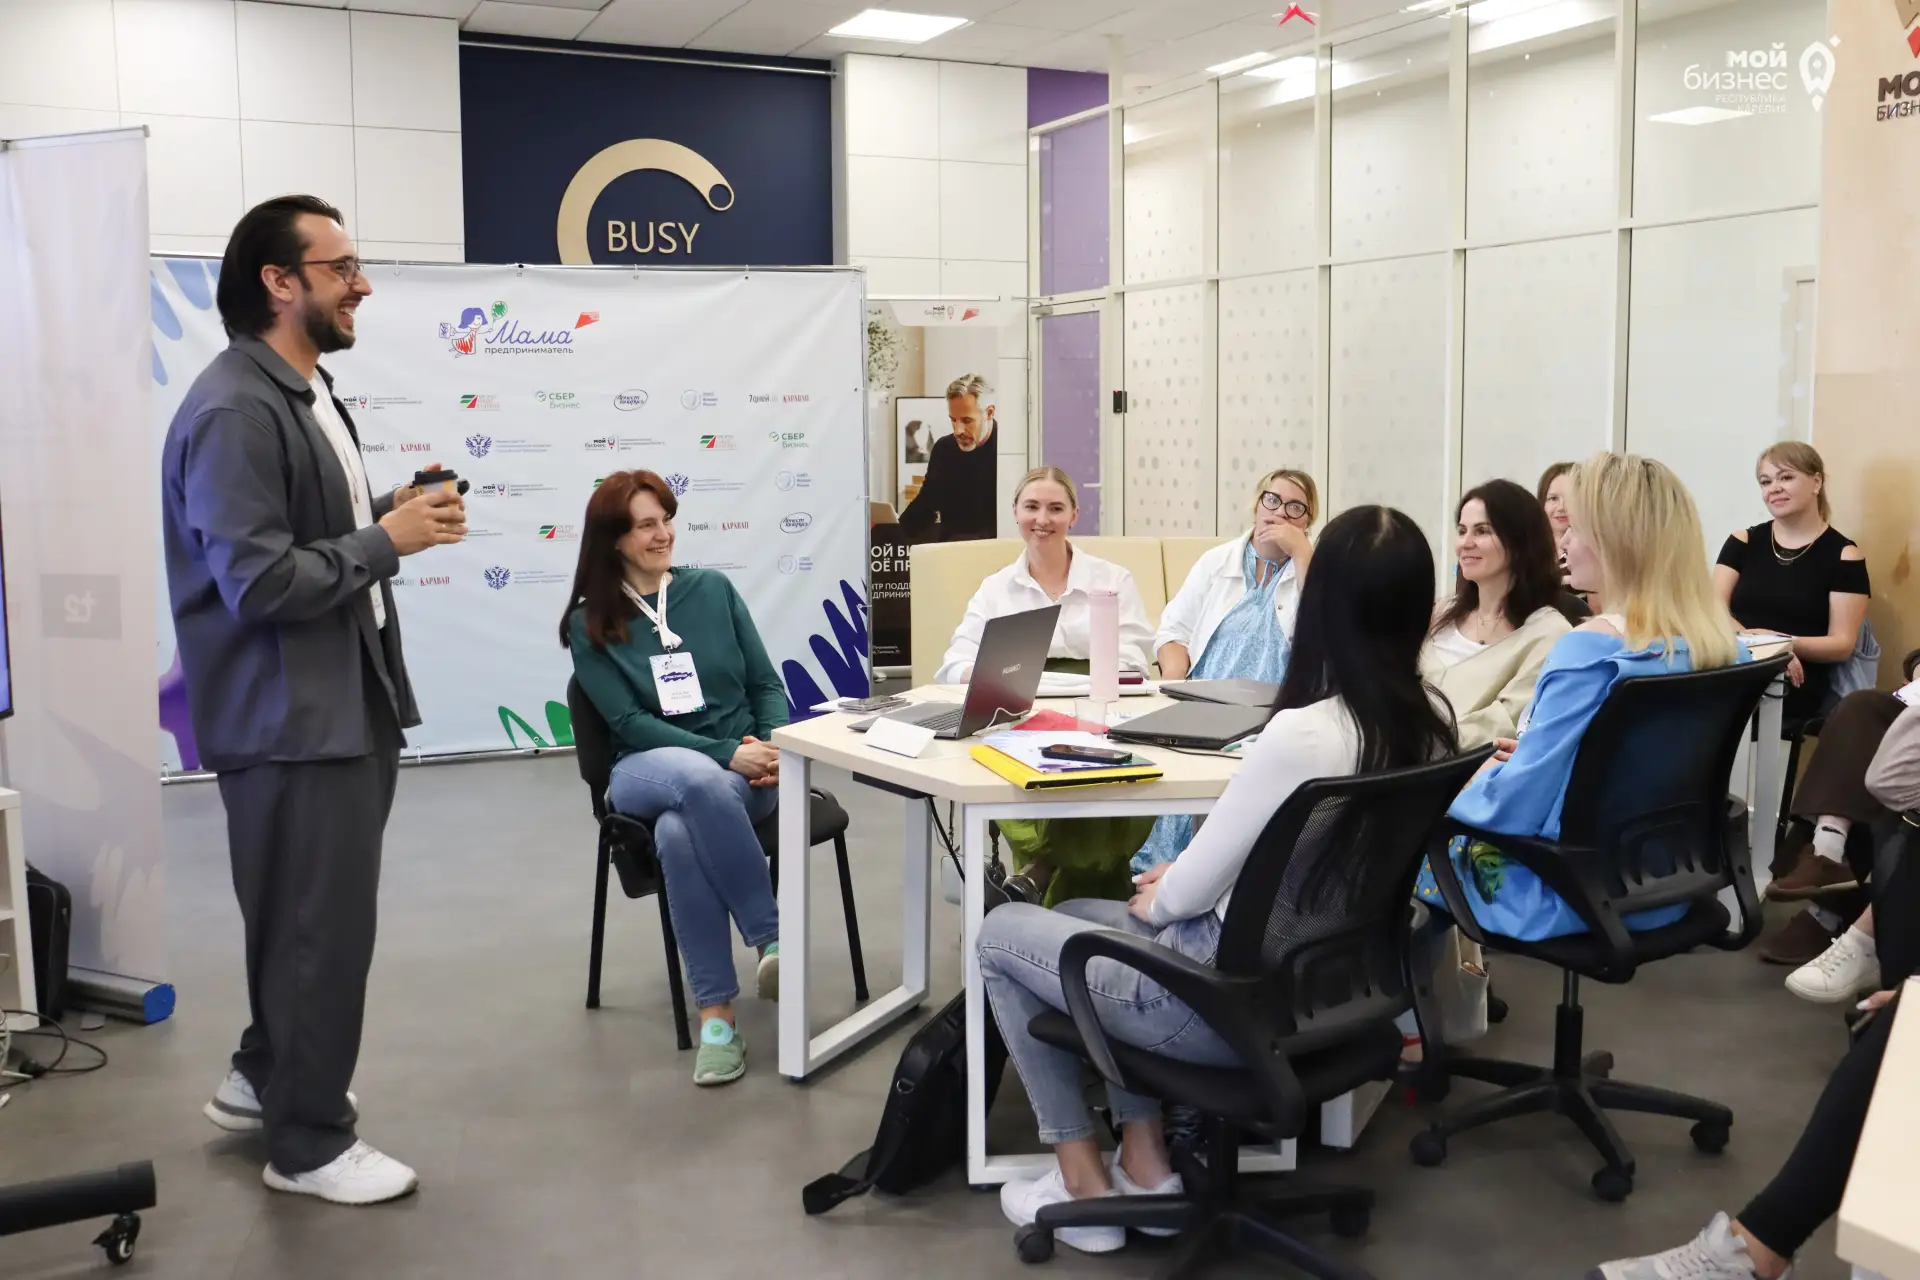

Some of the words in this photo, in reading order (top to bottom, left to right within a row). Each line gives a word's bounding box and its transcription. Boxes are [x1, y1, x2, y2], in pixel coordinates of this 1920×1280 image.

[607, 220, 700, 254] BUSY
[485, 319, 573, 345] Мама
[485, 347, 574, 355] предприниматель
[549, 392, 575, 400] СБЕР
[782, 432, 805, 440] СБЕР
[400, 443, 431, 452] КАРАВАН
[722, 521, 749, 531] КАРАВАН
[420, 576, 450, 586] КАРАВАН
[885, 582, 911, 591] ПОДД
